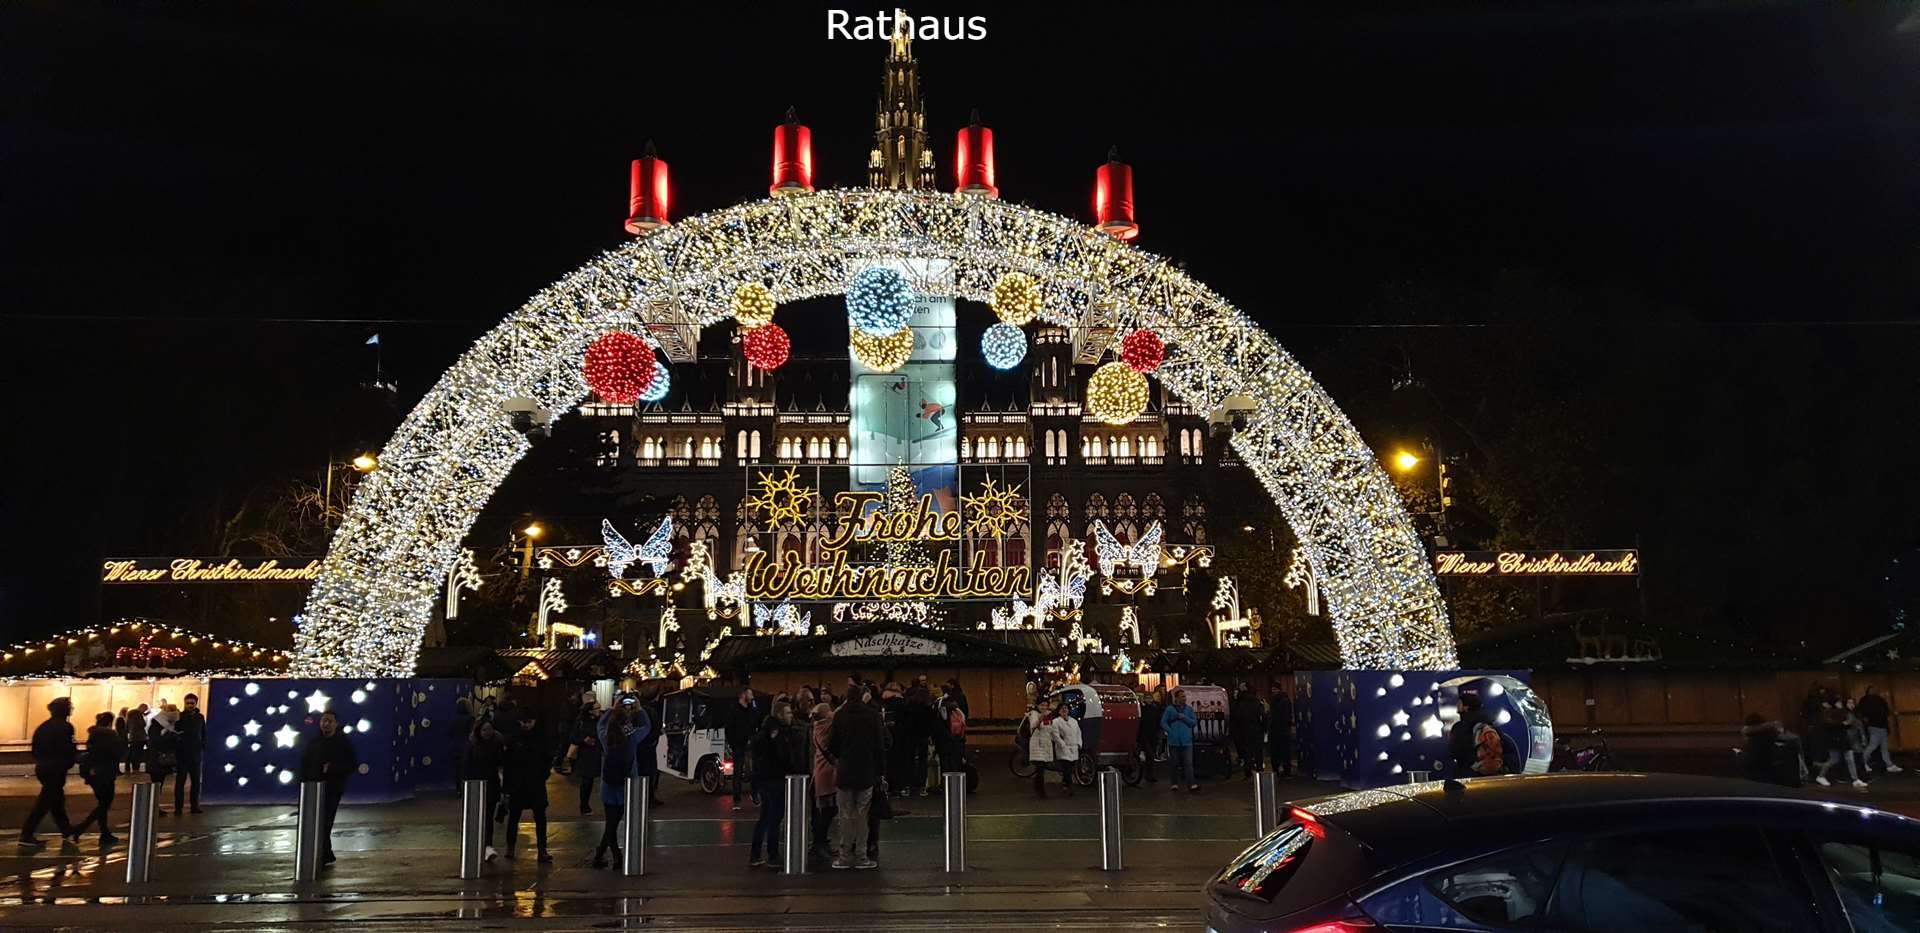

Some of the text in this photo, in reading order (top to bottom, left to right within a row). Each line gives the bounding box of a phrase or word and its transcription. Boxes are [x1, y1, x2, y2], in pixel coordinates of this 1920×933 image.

[929, 295, 947, 303] am
[819, 491, 962, 550] Frohe
[104, 558, 321, 581] Wiener Christkindlmarkt
[745, 549, 1032, 598] Weihnachten
[1437, 551, 1637, 574] Wiener Christkindlmarkt
[854, 634, 924, 650] Naschkatze
